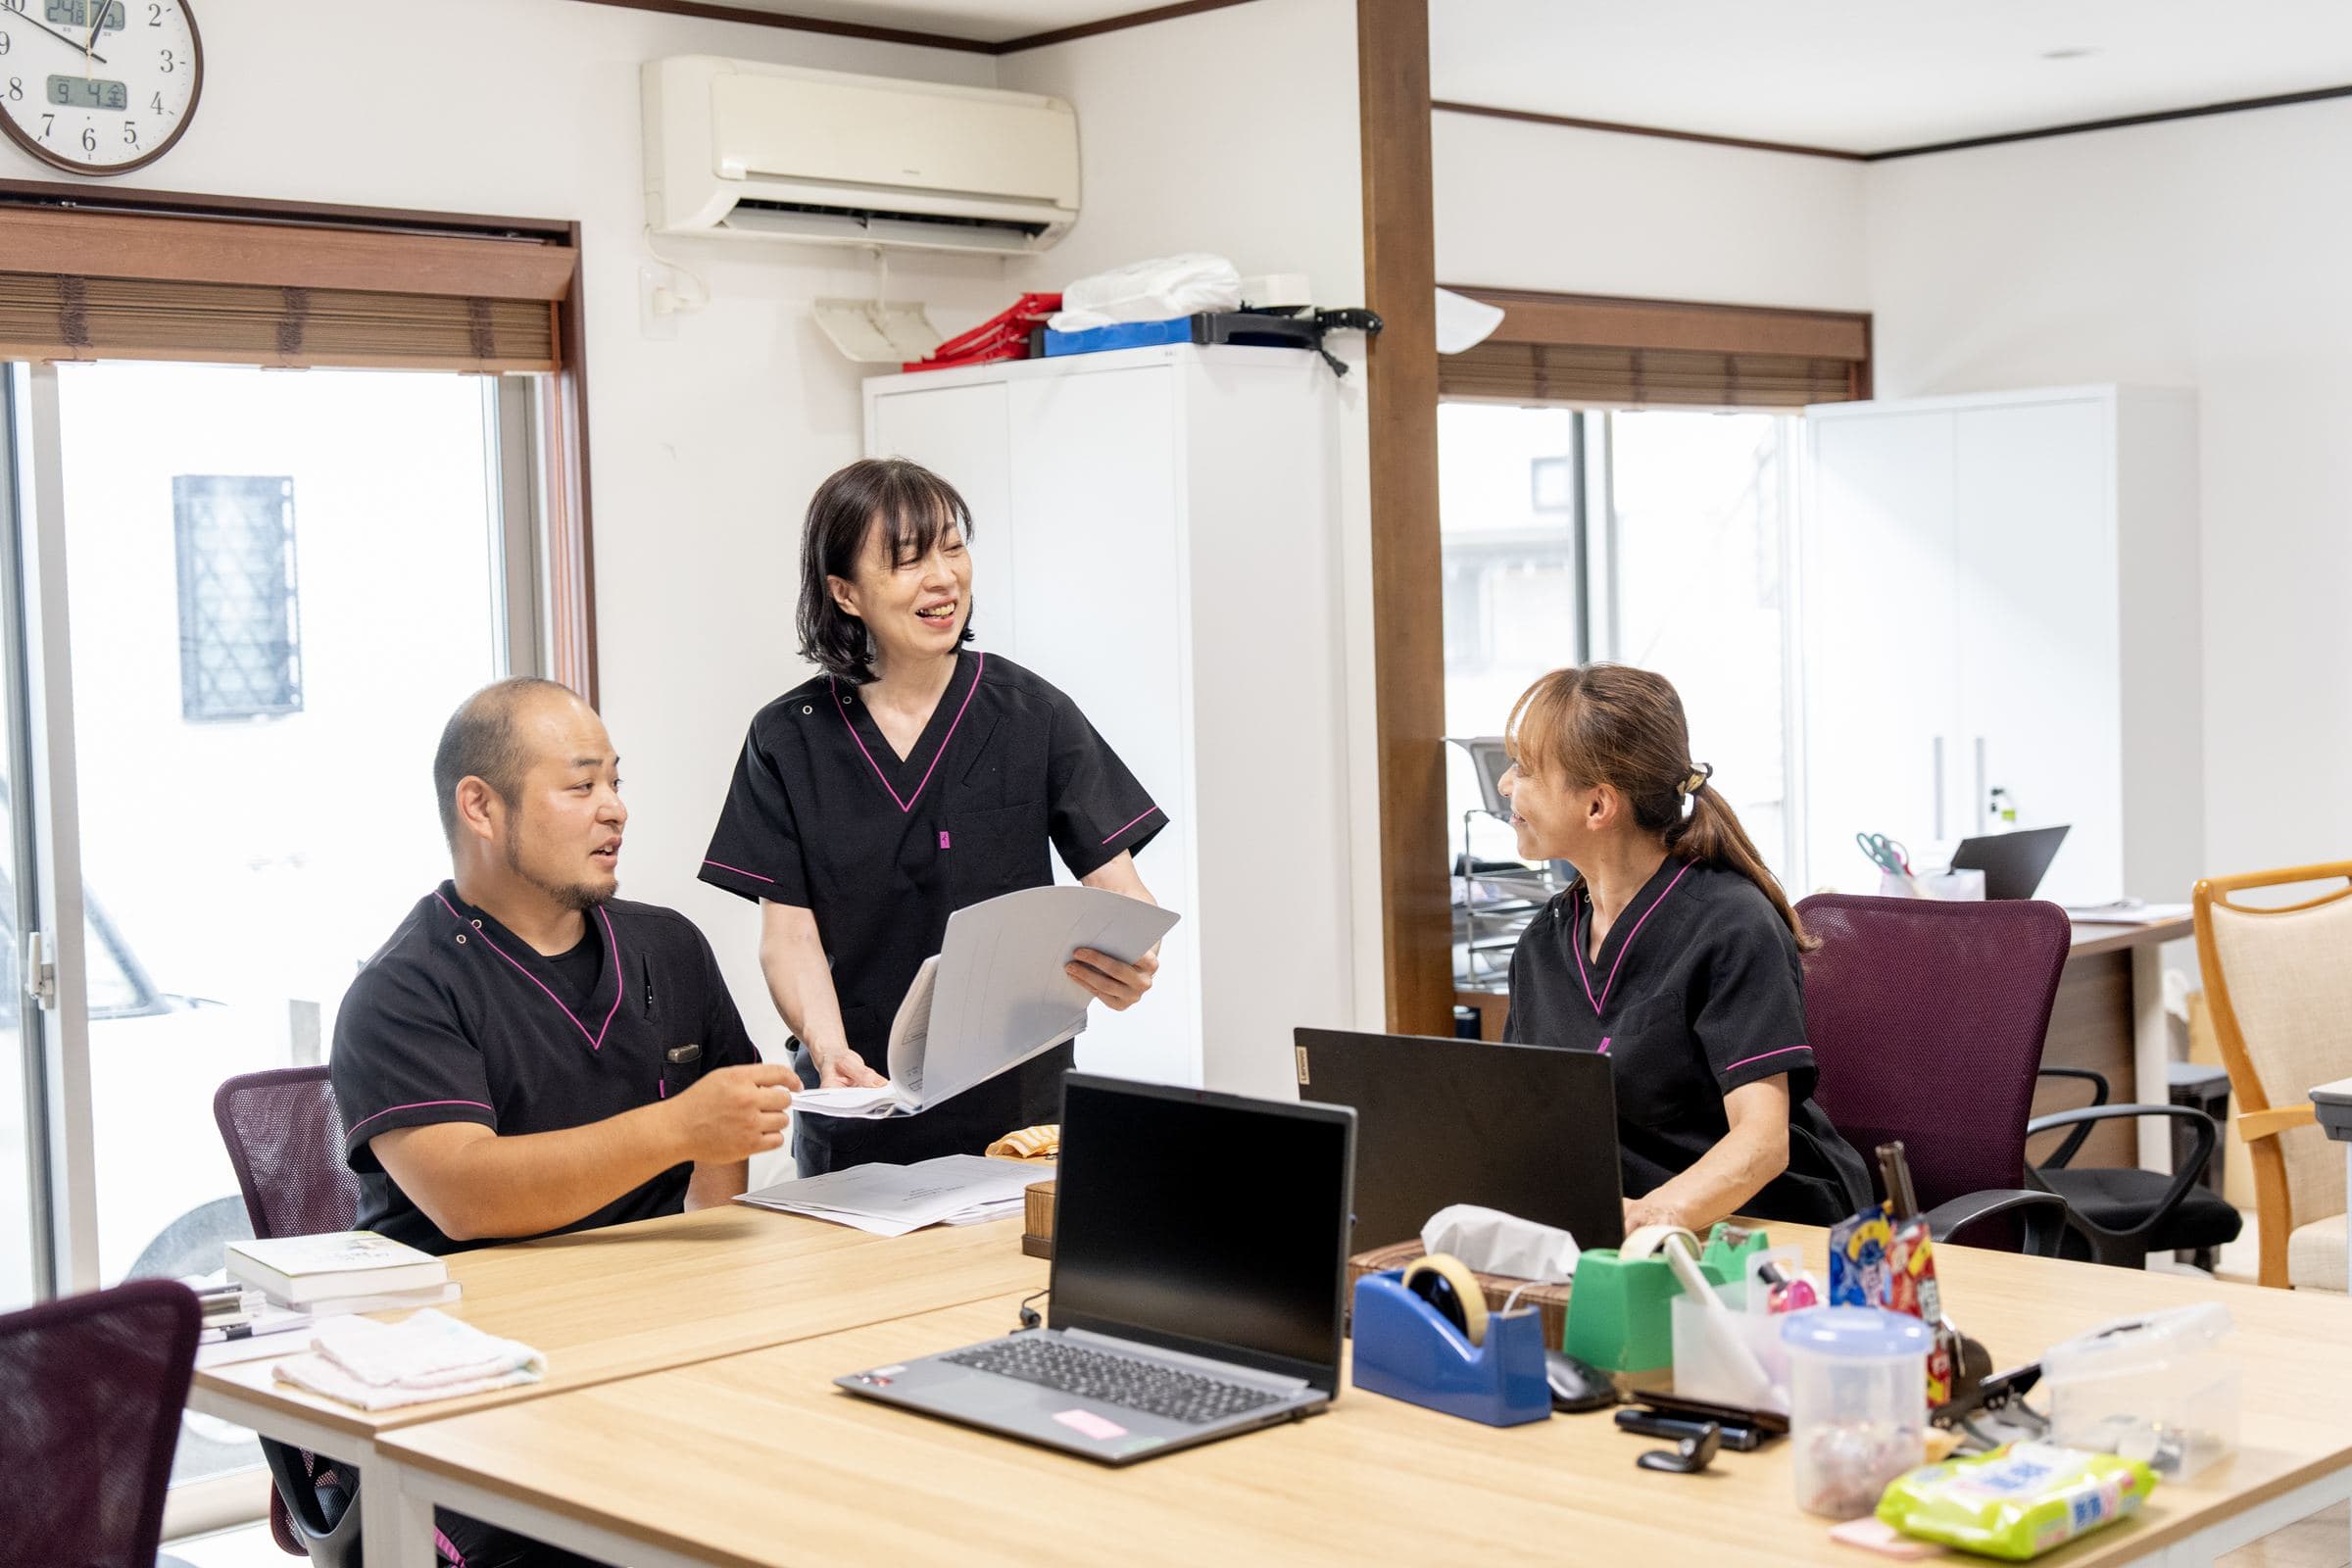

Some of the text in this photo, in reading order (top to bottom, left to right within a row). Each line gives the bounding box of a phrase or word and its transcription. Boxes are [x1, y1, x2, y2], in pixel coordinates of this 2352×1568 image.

[148, 3, 162, 27] 2
[0, 30, 11, 56] 9
[160, 49, 174, 74] 3
[9, 76, 24, 102] 8
[150, 91, 165, 116] 4
[41, 114, 55, 137] 7
[123, 121, 137, 145] 5
[81, 127, 96, 152] 6
